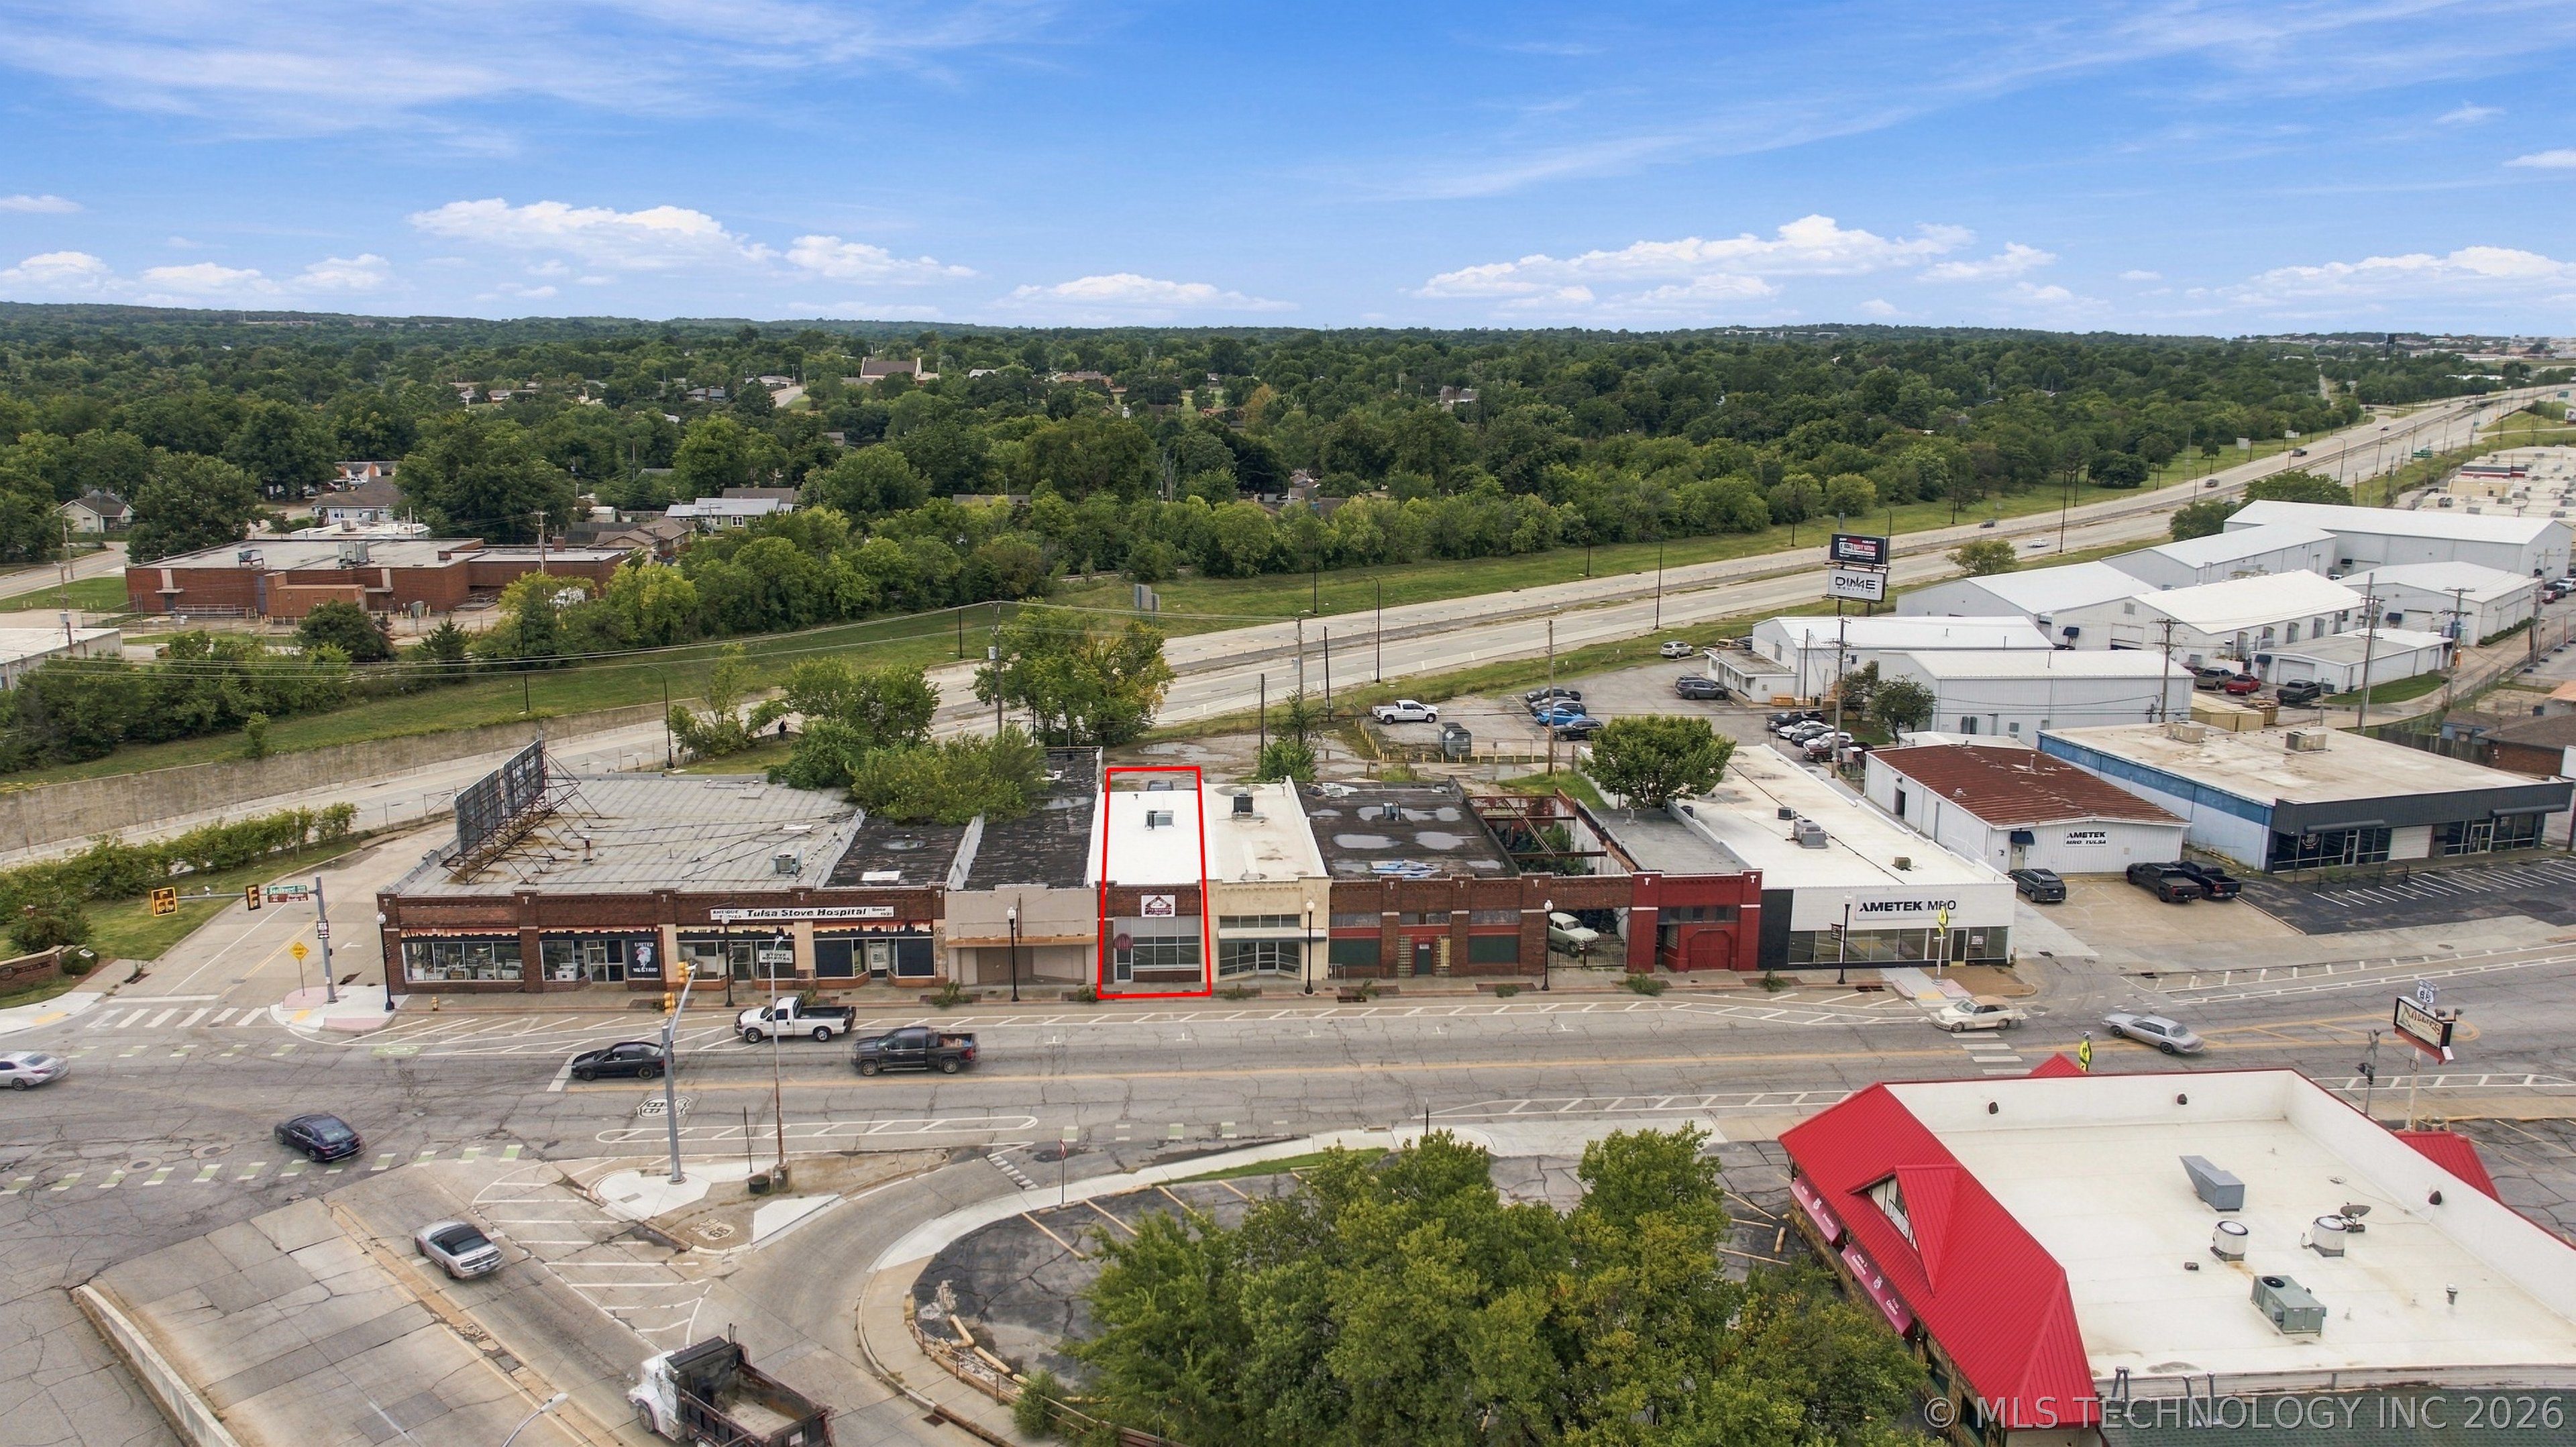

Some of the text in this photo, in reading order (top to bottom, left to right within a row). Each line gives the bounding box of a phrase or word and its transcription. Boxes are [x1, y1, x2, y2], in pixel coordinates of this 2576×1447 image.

[1835, 576, 1876, 590] DIME
[1859, 901, 1923, 912] AMETEK
[782, 909, 814, 917] Stove
[817, 908, 867, 917] Hospital
